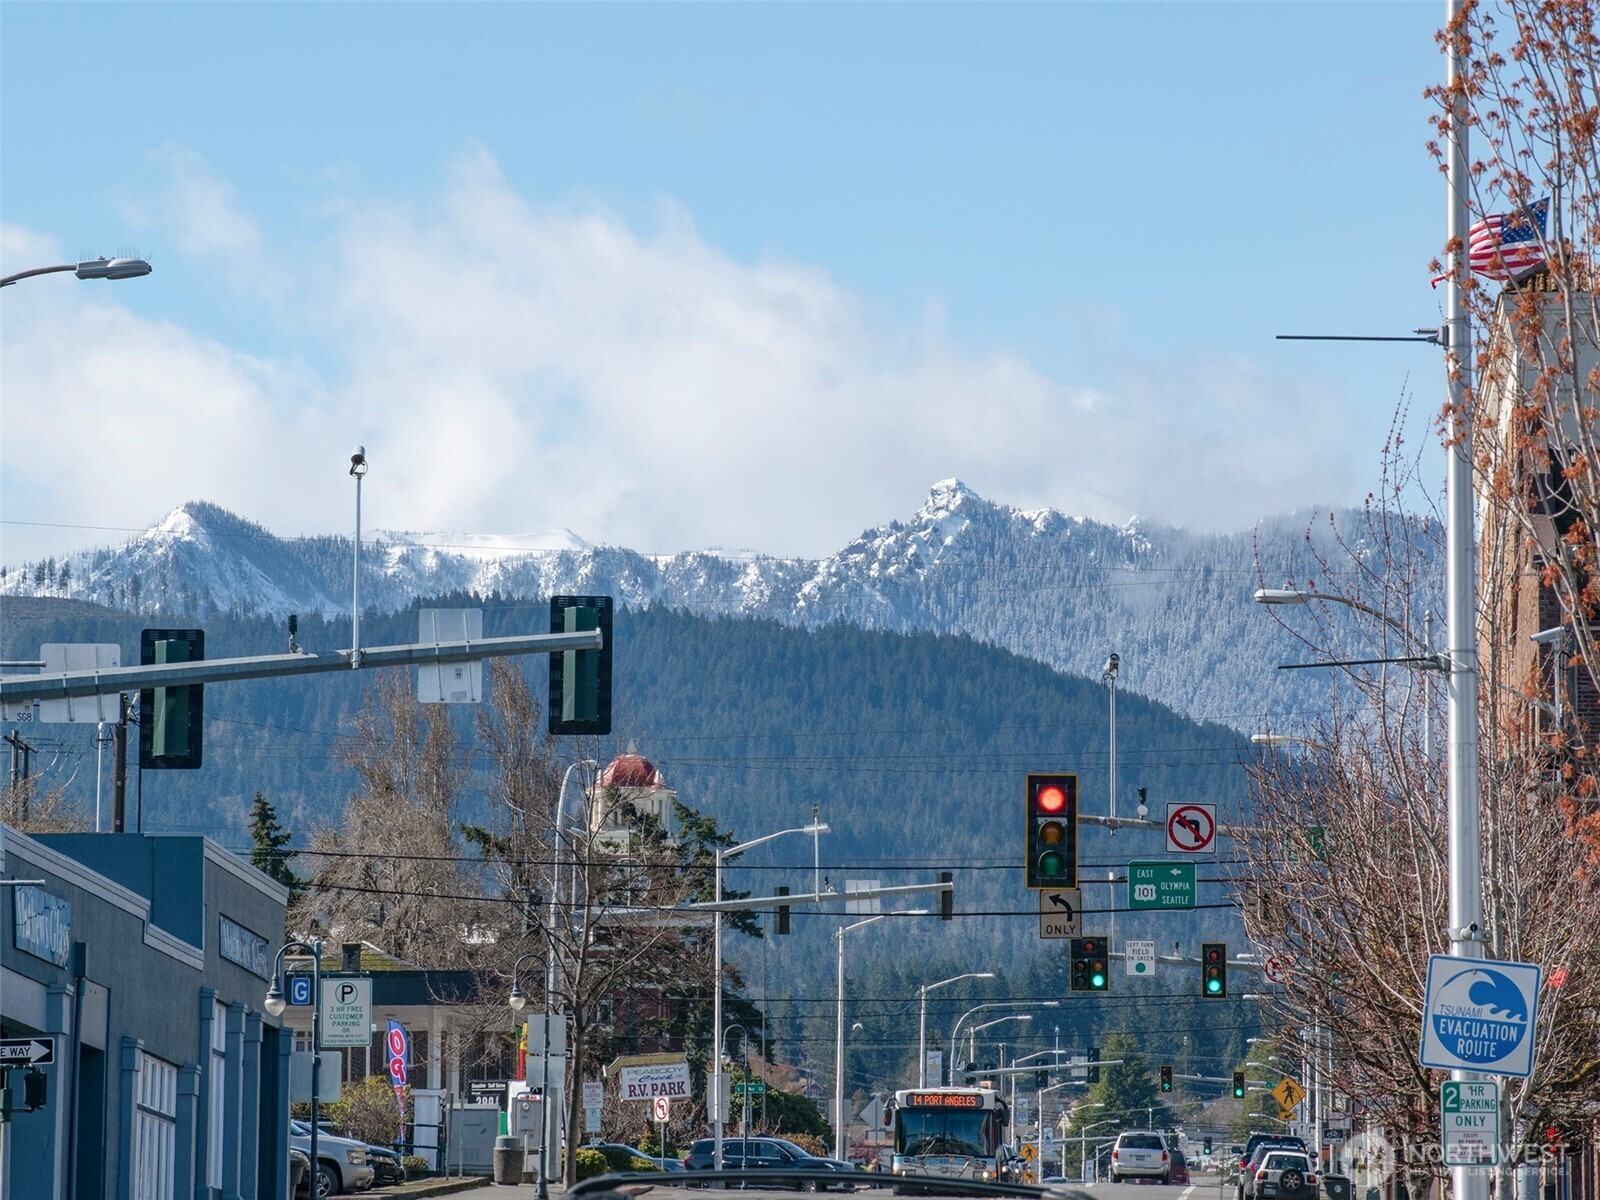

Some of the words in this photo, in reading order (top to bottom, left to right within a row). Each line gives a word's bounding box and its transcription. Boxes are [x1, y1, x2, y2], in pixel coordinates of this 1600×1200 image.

[16, 712, 33, 722] SG8
[1137, 869, 1154, 878] EAST
[1160, 881, 1190, 890] OLYMPIA
[1138, 887, 1154, 898] 101
[1161, 895, 1190, 905] SEATTLE
[1046, 924, 1076, 934] ONLY
[294, 981, 308, 1001] G
[341, 984, 354, 1002] P
[1440, 1004, 1483, 1018] TSUNAMI
[1439, 1018, 1518, 1042] EVACUATION
[10, 1046, 30, 1057] WAY
[1457, 1038, 1497, 1058] ROUTE
[627, 1066, 684, 1076] PEABODY
[638, 1073, 674, 1083] Creek
[628, 1083, 649, 1098] R.V.
[650, 1081, 687, 1097] PARK
[913, 1095, 923, 1106] 14
[924, 1095, 943, 1106] PORT
[944, 1096, 977, 1107] ANGELES
[1445, 1086, 1458, 1108] 2
[1470, 1085, 1485, 1096] HR
[1460, 1098, 1496, 1110] PARKING
[1455, 1115, 1486, 1127] ONLY
